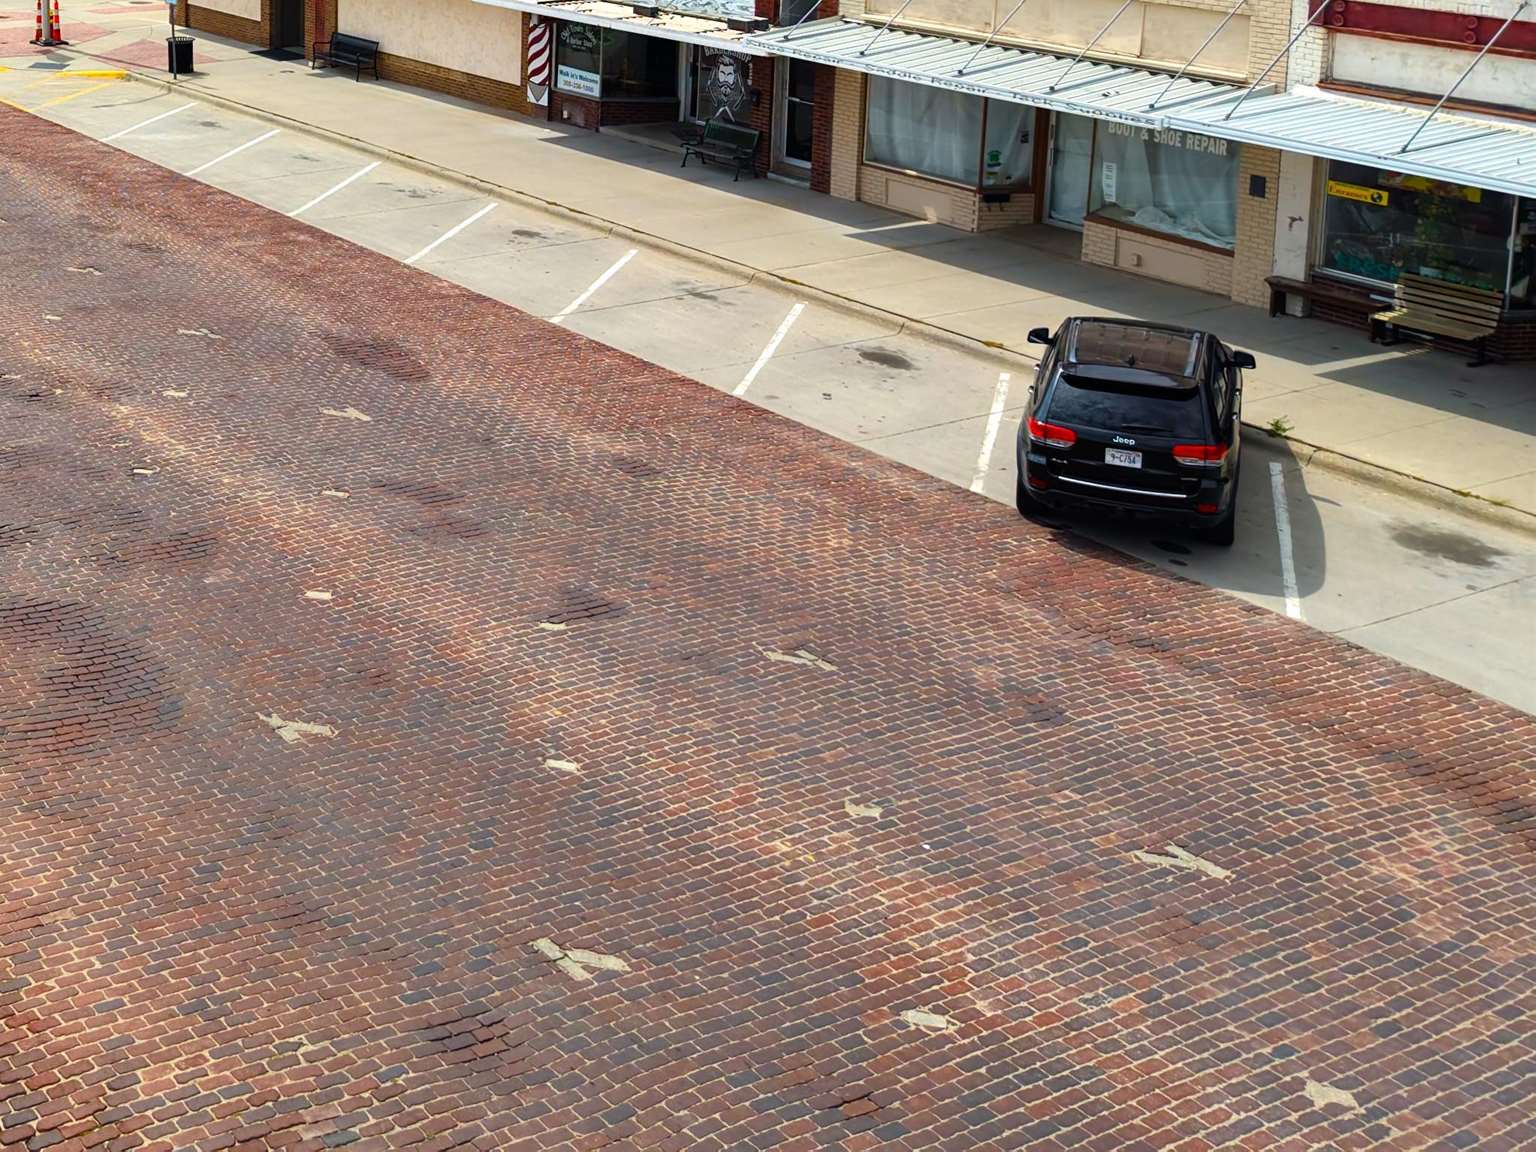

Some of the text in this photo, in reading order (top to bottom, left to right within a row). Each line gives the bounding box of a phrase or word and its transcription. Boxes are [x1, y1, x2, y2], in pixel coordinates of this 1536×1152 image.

[792, 48, 841, 63] Repair
[864, 63, 923, 81] Saddle
[931, 77, 986, 93] Repair
[1065, 102, 1156, 126] Supplies
[1153, 129, 1183, 148] SHOE
[1186, 134, 1228, 156] REPAIR
[1112, 435, 1136, 446] Jeep
